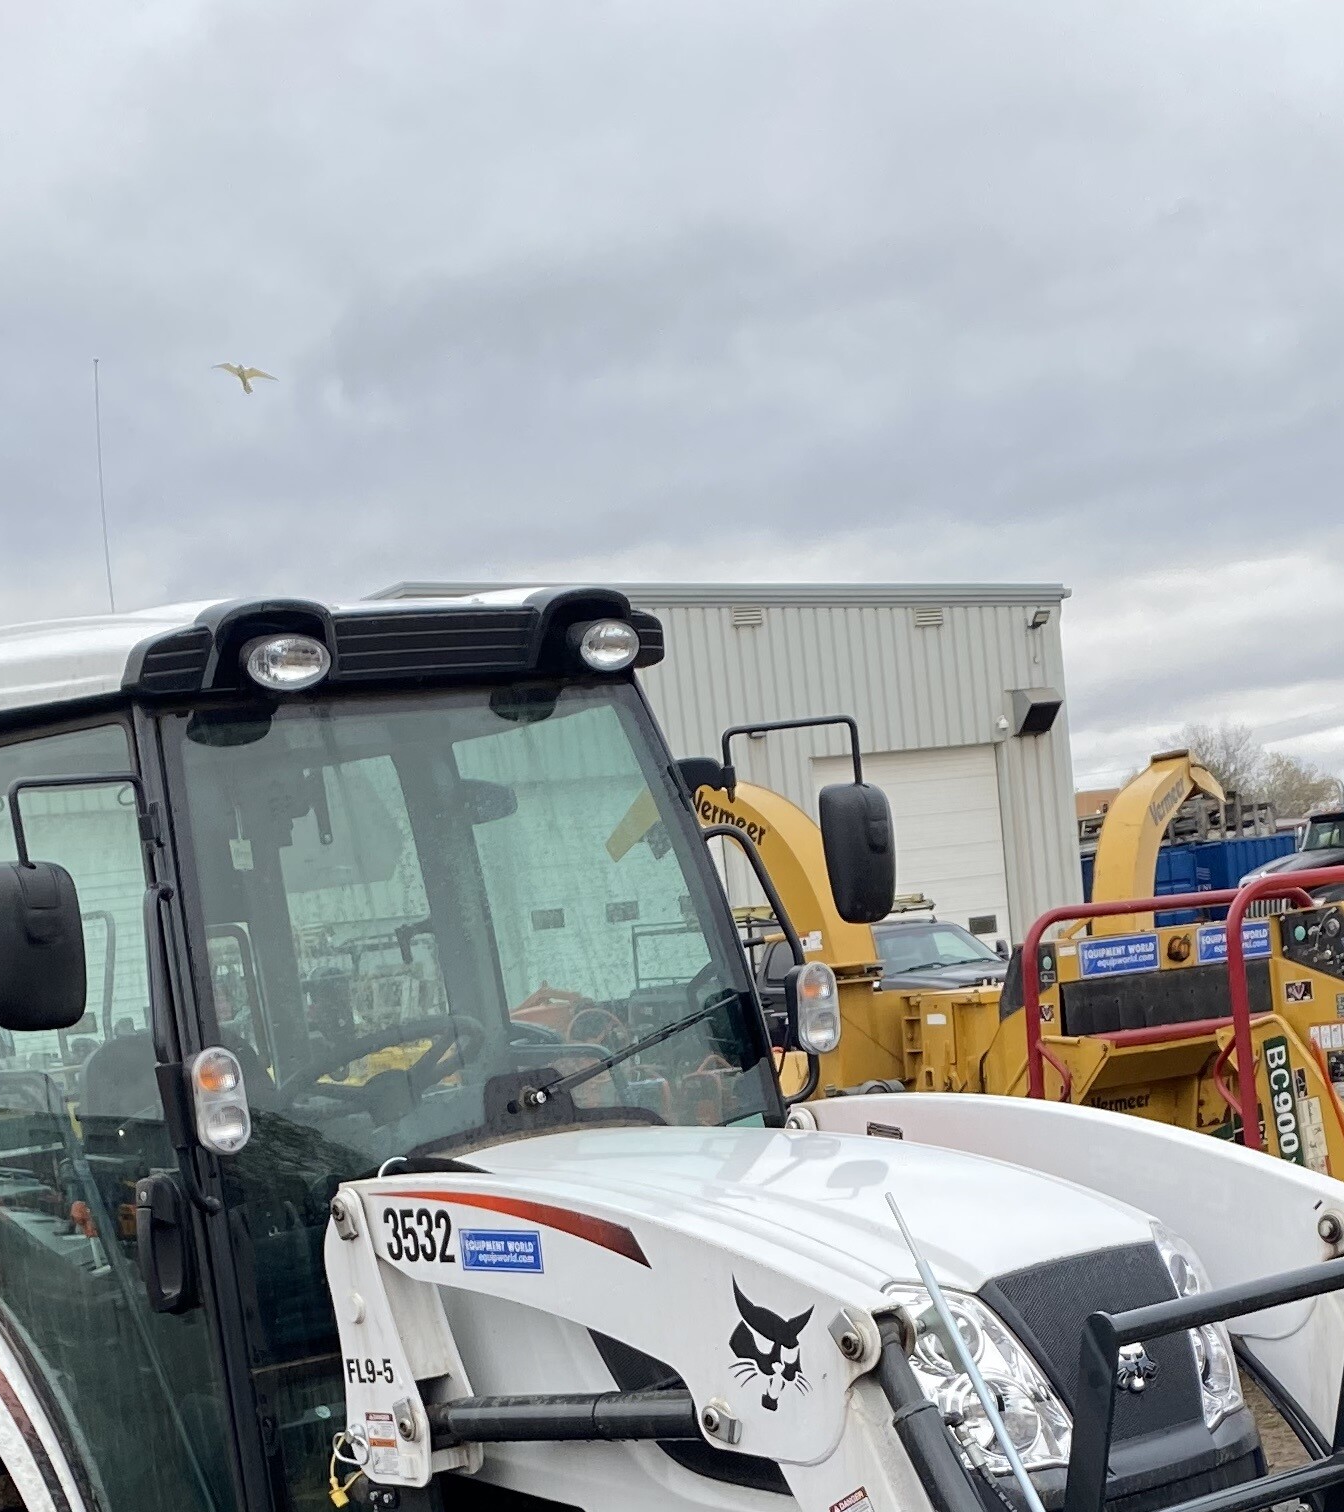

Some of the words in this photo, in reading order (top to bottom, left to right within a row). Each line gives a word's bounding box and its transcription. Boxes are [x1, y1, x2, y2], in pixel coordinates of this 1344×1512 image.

[693, 790, 766, 846] Vermeer
[1243, 929, 1268, 941] WORLD
[1084, 945, 1126, 960] EQUIPMENT
[1128, 942, 1155, 955] WORLD
[1096, 953, 1155, 968] equipworld.com
[383, 1207, 456, 1263] 3532
[465, 1239, 505, 1251] EQUIPMENT
[507, 1241, 534, 1253] WORLD
[478, 1252, 535, 1265] equipworld.com
[346, 1358, 394, 1383] FL9-5
